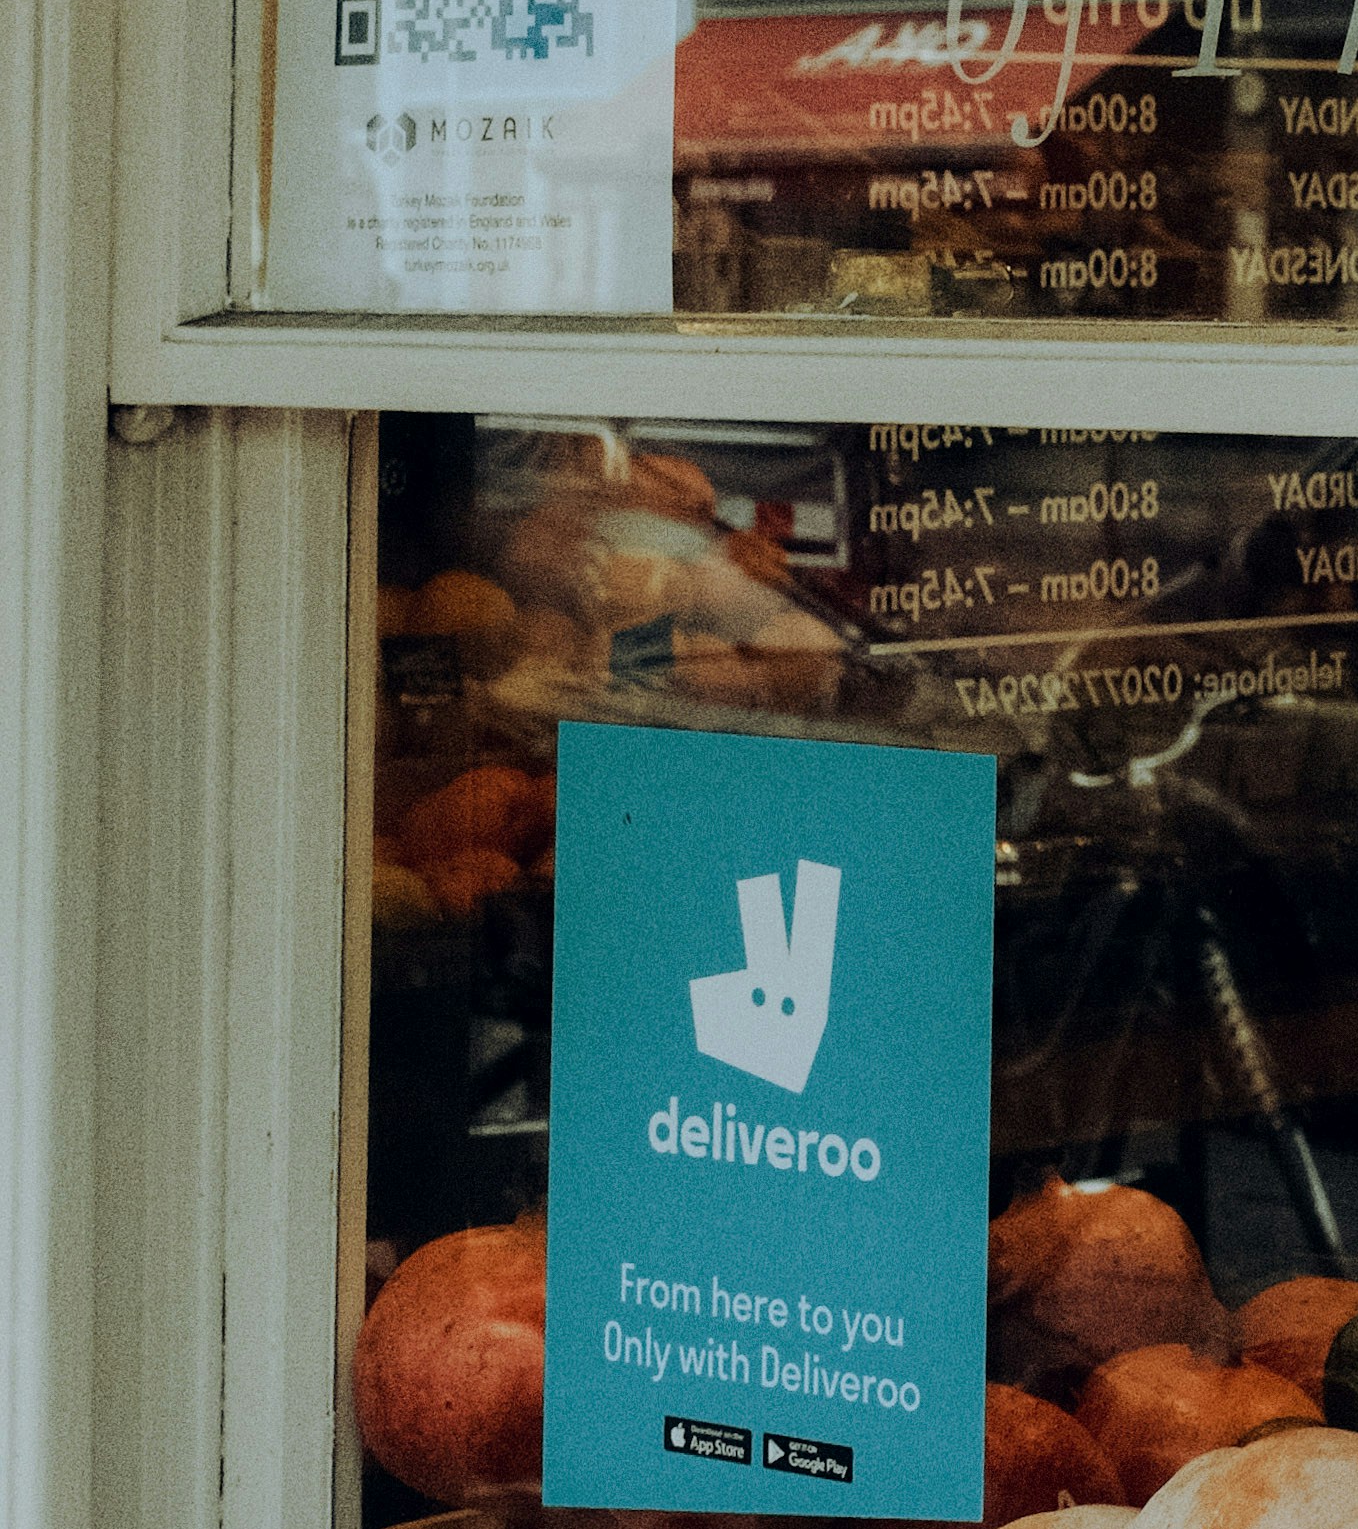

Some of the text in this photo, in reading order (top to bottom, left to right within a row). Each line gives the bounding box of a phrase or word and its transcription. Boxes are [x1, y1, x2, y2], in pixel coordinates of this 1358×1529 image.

[431, 116, 555, 142] MOZAIK
[469, 214, 513, 231] England
[649, 1096, 881, 1182] deliveroo
[620, 1262, 904, 1353] From here to you
[604, 1320, 921, 1412] Only with Deliveroo
[690, 1435, 745, 1459] App Store
[788, 1452, 848, 1479] Google Play
